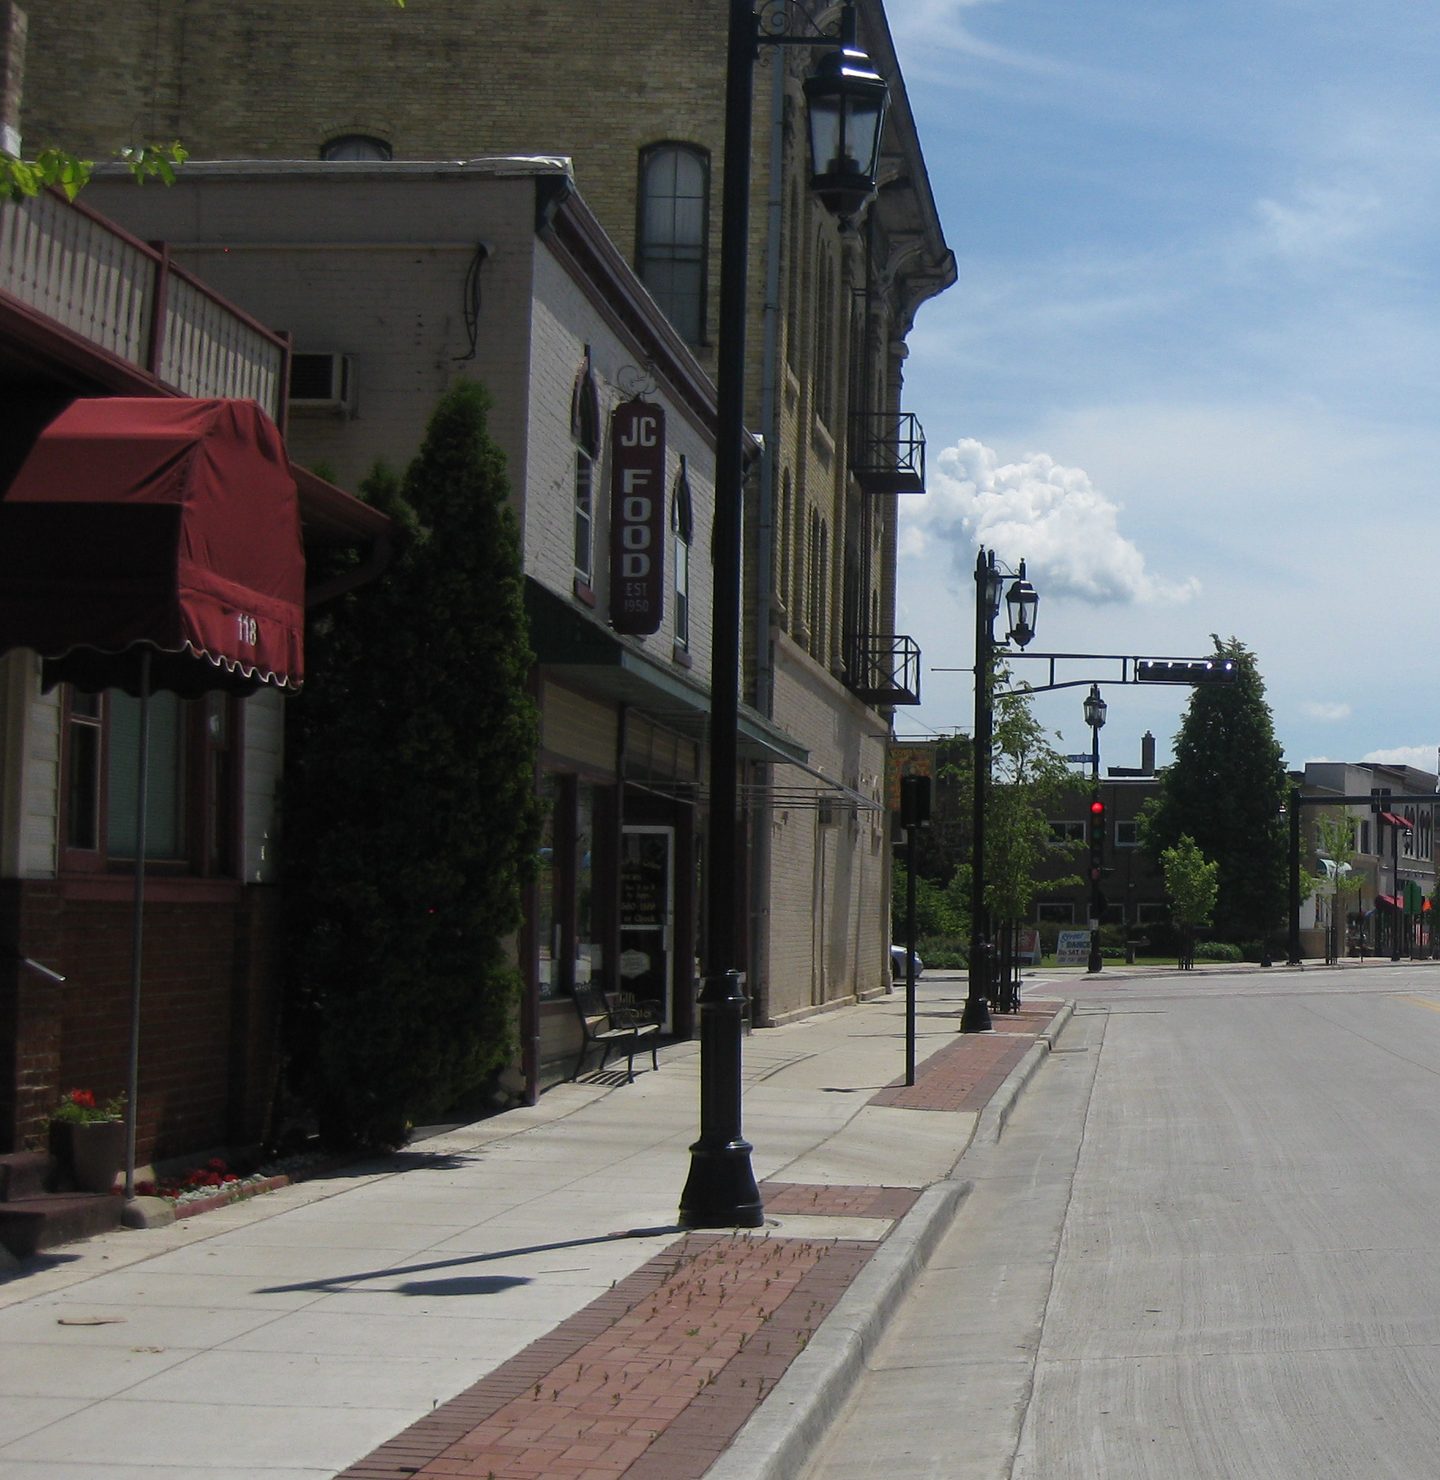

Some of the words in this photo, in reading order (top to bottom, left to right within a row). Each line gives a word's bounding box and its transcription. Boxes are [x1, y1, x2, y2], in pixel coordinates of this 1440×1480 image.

[621, 416, 656, 447] JC
[623, 470, 652, 577] FOOD
[624, 582, 648, 597] EST
[238, 613, 257, 646] 118
